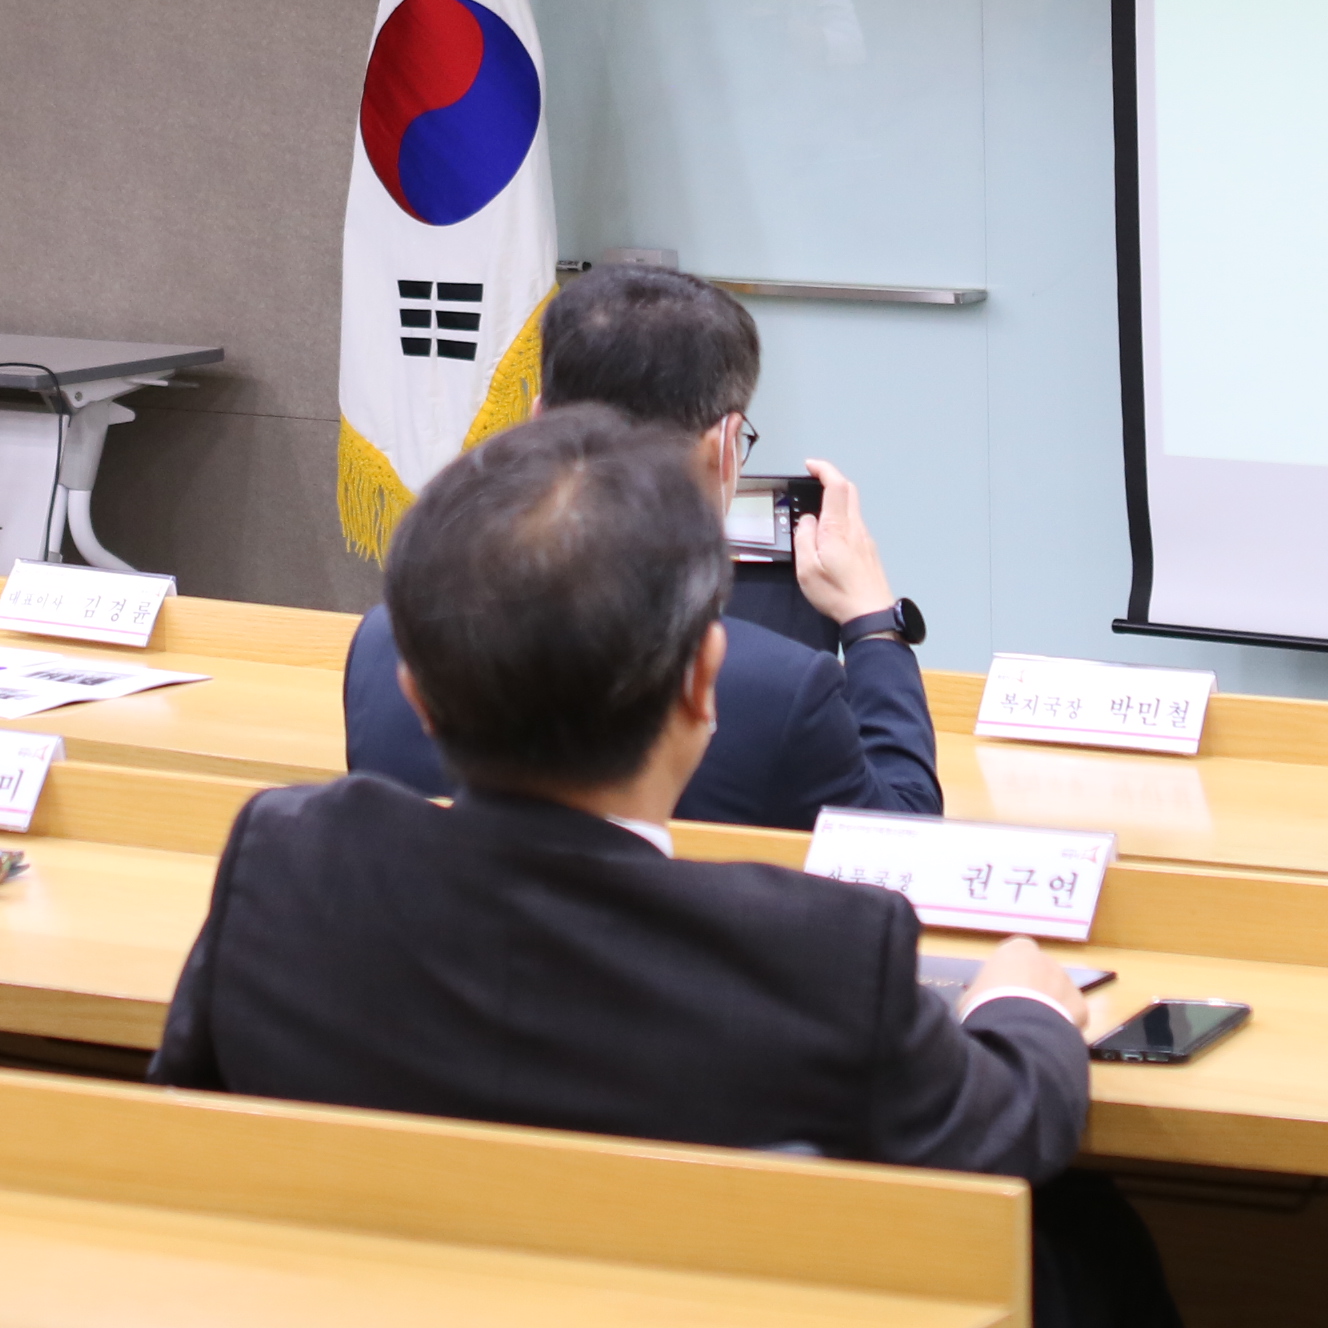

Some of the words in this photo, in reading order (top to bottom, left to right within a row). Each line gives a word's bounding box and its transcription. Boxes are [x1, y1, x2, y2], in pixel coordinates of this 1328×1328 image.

[8, 589, 64, 612] 대표이사
[1000, 692, 1084, 721] 복지국장
[1109, 695, 1191, 729] 박민철
